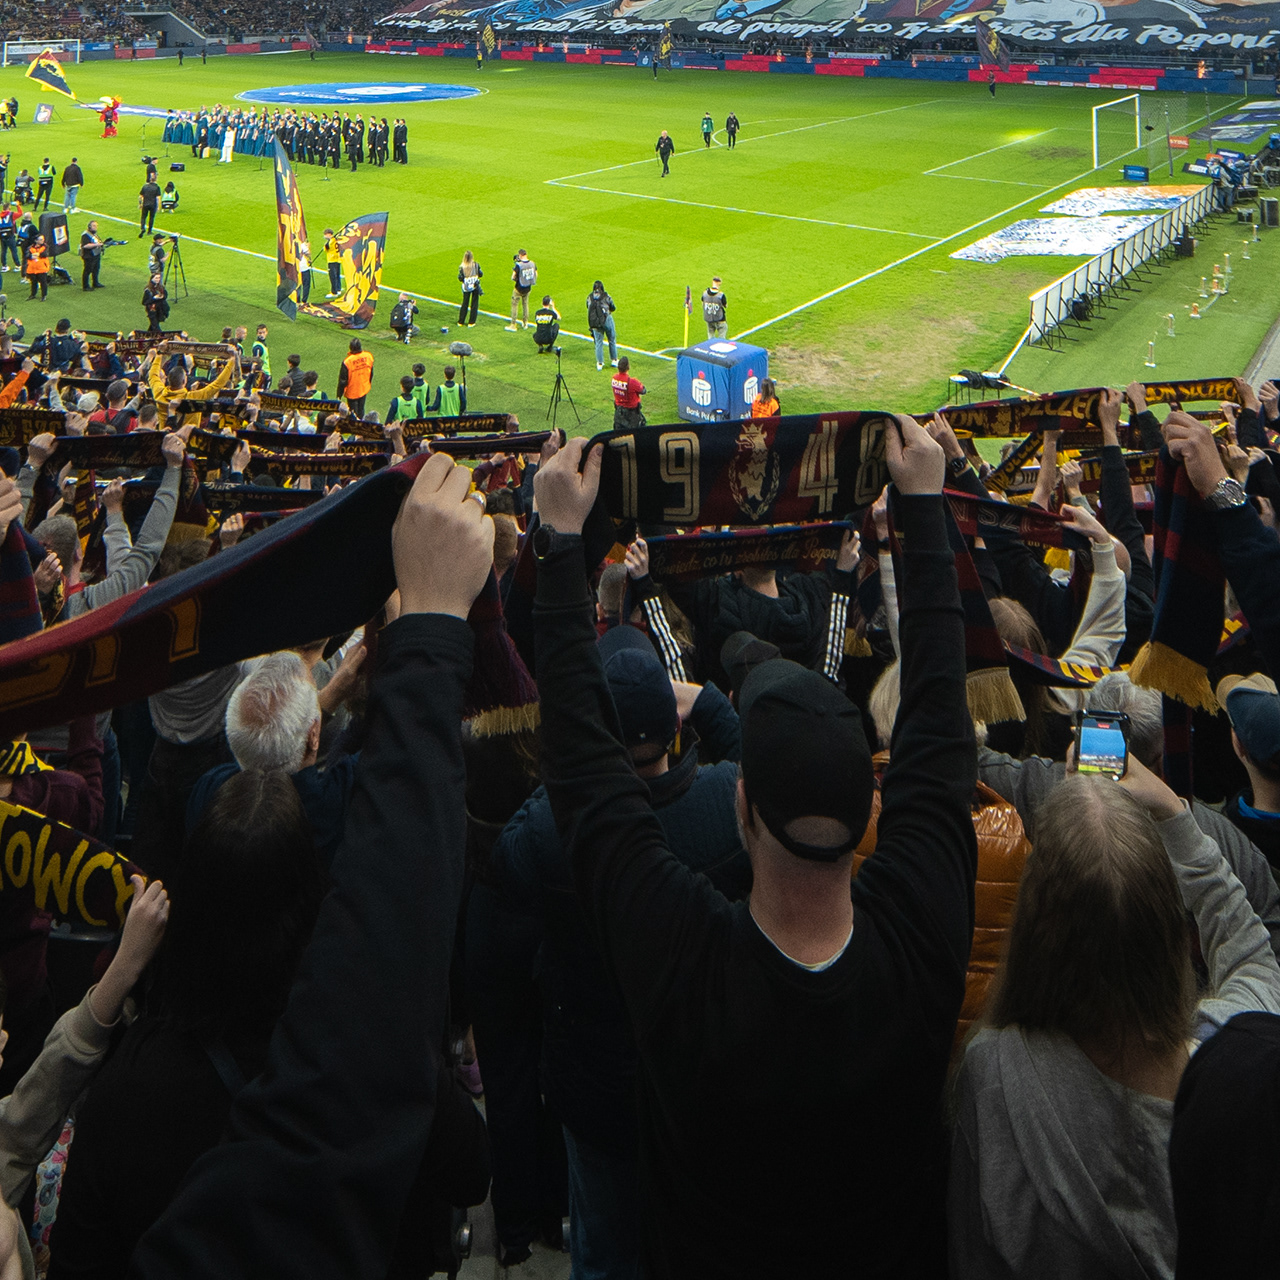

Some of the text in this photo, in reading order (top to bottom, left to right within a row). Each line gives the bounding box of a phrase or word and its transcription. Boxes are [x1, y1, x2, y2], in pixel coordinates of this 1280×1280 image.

[697, 20, 742, 35] ale
[856, 22, 893, 33] co
[1062, 24, 1130, 43] dla
[704, 302, 720, 311] FOTO
